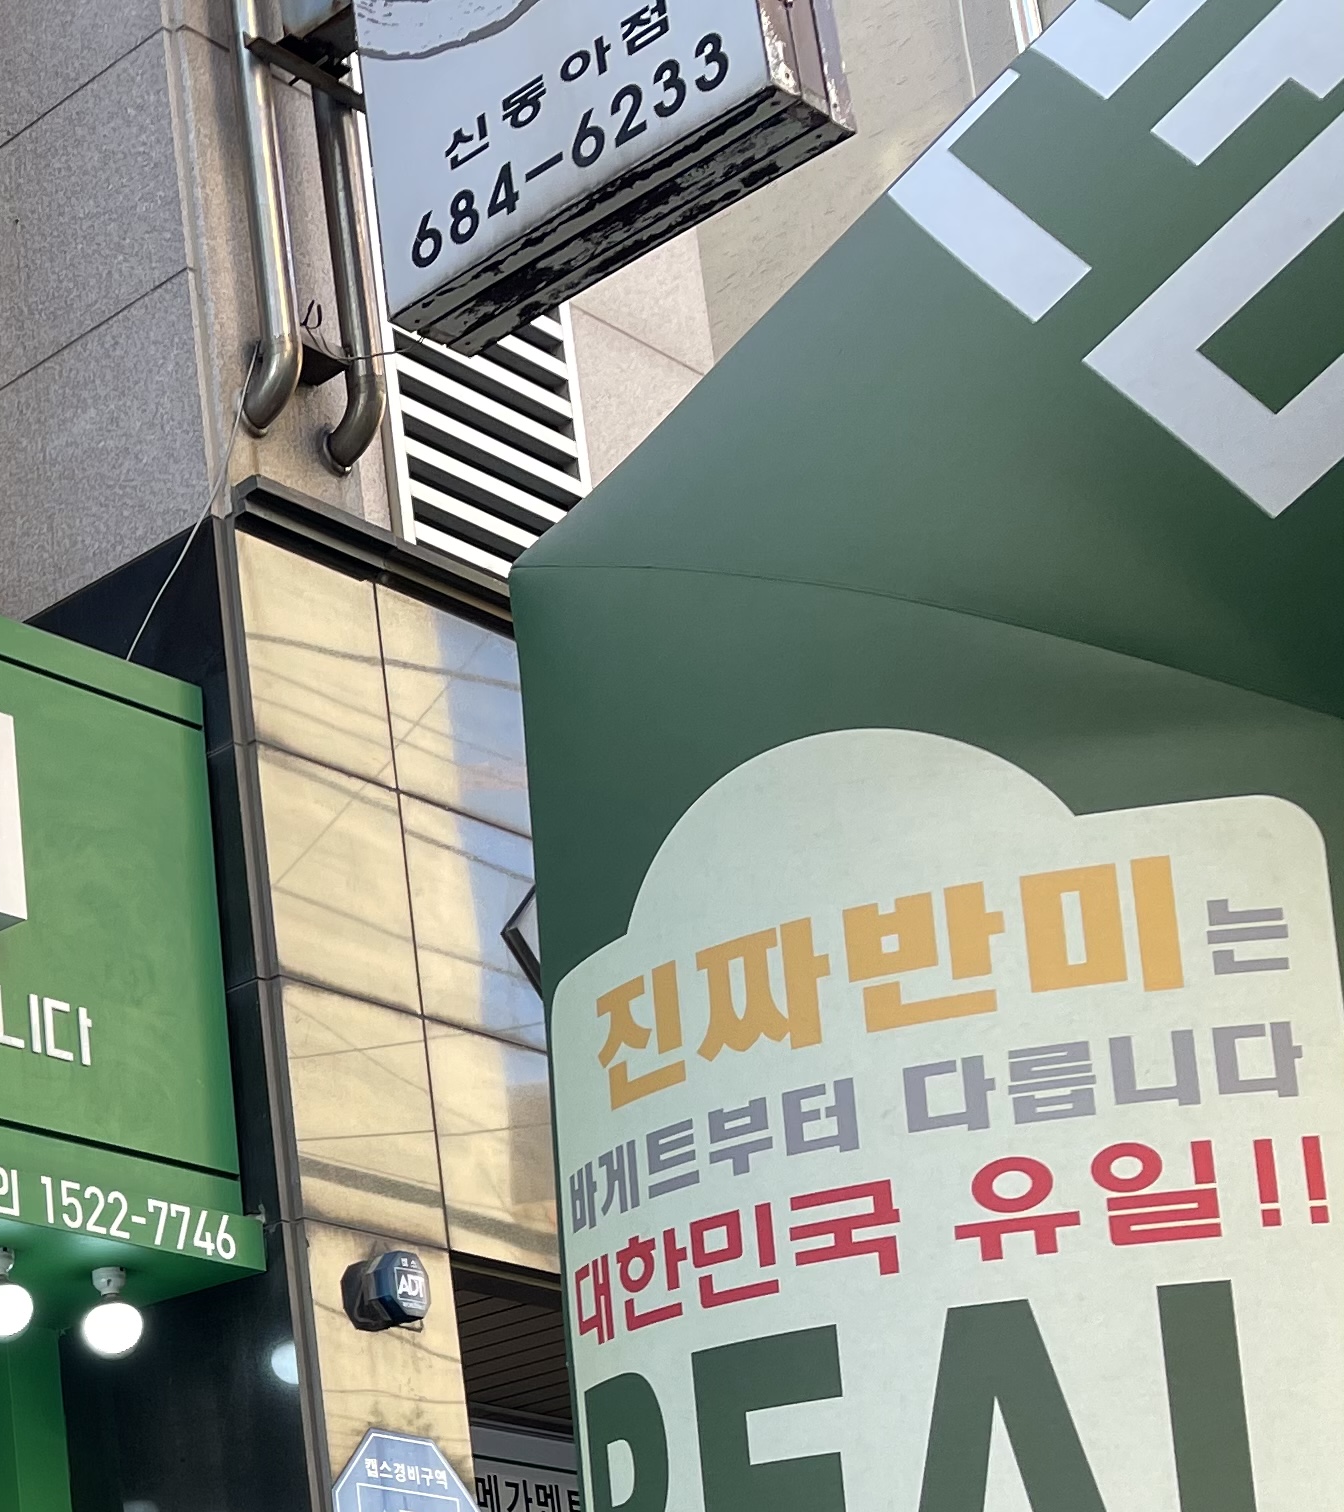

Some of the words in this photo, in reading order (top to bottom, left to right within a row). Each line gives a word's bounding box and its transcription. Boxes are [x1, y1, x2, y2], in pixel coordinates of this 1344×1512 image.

[412, 32, 729, 267] 684-6233
[445, 0, 669, 170] 신동아점
[569, 1077, 862, 1235] 바게트부터
[903, 1022, 1303, 1134] 다릅니다
[40, 1175, 236, 1260] 1522-7746
[398, 1274, 424, 1298] ADT
[574, 1179, 901, 1345] 대한민국
[954, 1135, 1330, 1261] 유일!!
[364, 1458, 448, 1489] 캡스경비구역
